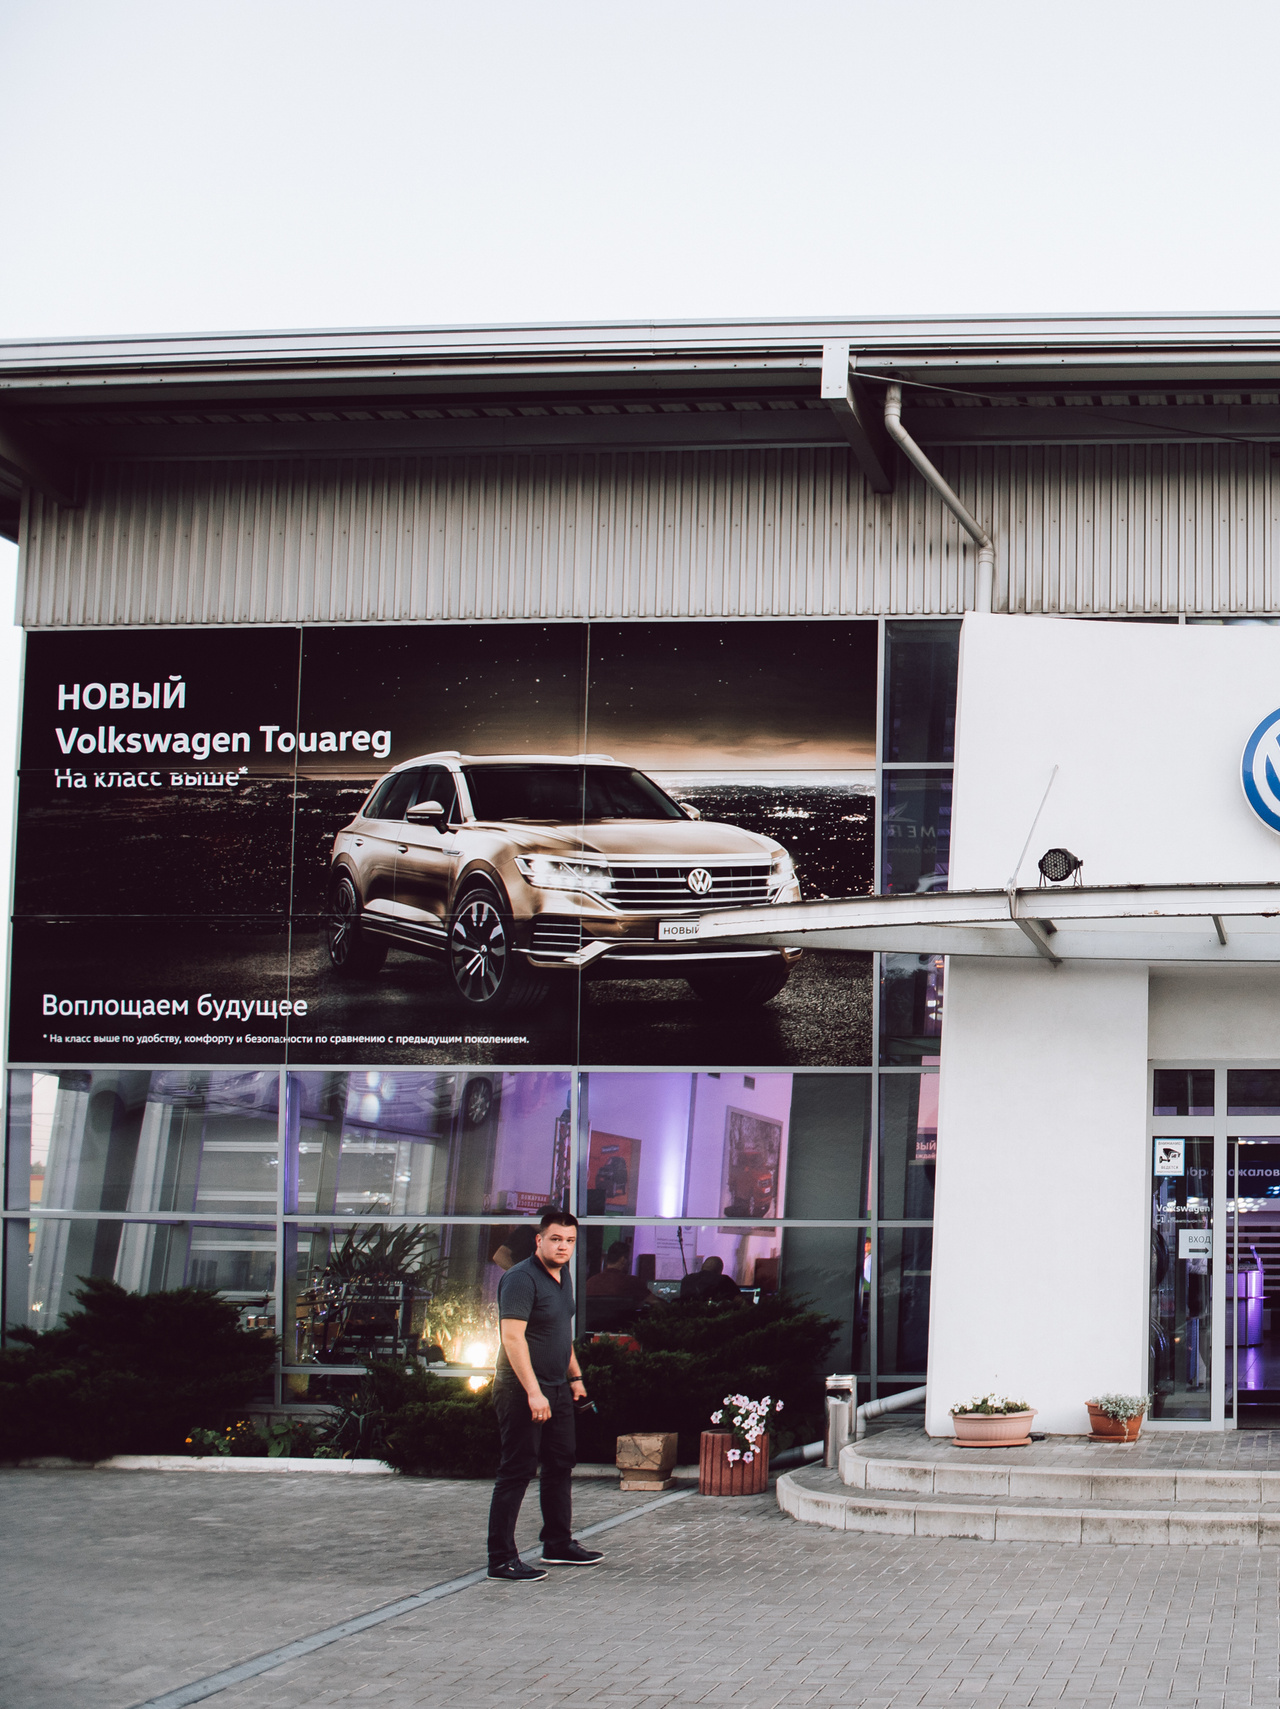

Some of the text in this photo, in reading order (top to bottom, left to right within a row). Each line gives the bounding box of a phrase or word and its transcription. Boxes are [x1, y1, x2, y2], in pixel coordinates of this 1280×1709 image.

[59, 674, 186, 711] НОВЫЙ
[55, 725, 392, 761] Volkswagen Touareg
[54, 768, 88, 789] На
[94, 770, 162, 788] класс
[42, 993, 308, 1022] Воплощаем будущее
[50, 1034, 63, 1043] На
[65, 1035, 91, 1043] класс
[93, 1035, 120, 1043] выше
[122, 1035, 134, 1043] по
[136, 1033, 182, 1045] удобству,
[184, 1033, 234, 1045] комфорту
[236, 1035, 243, 1043] и
[315, 1035, 328, 1044] по
[329, 1035, 386, 1045] сравнению
[387, 1035, 394, 1044] с
[396, 1035, 462, 1046] предыдущим
[464, 1035, 530, 1044] поколением.
[1188, 1235, 1212, 1244] ВХОД
